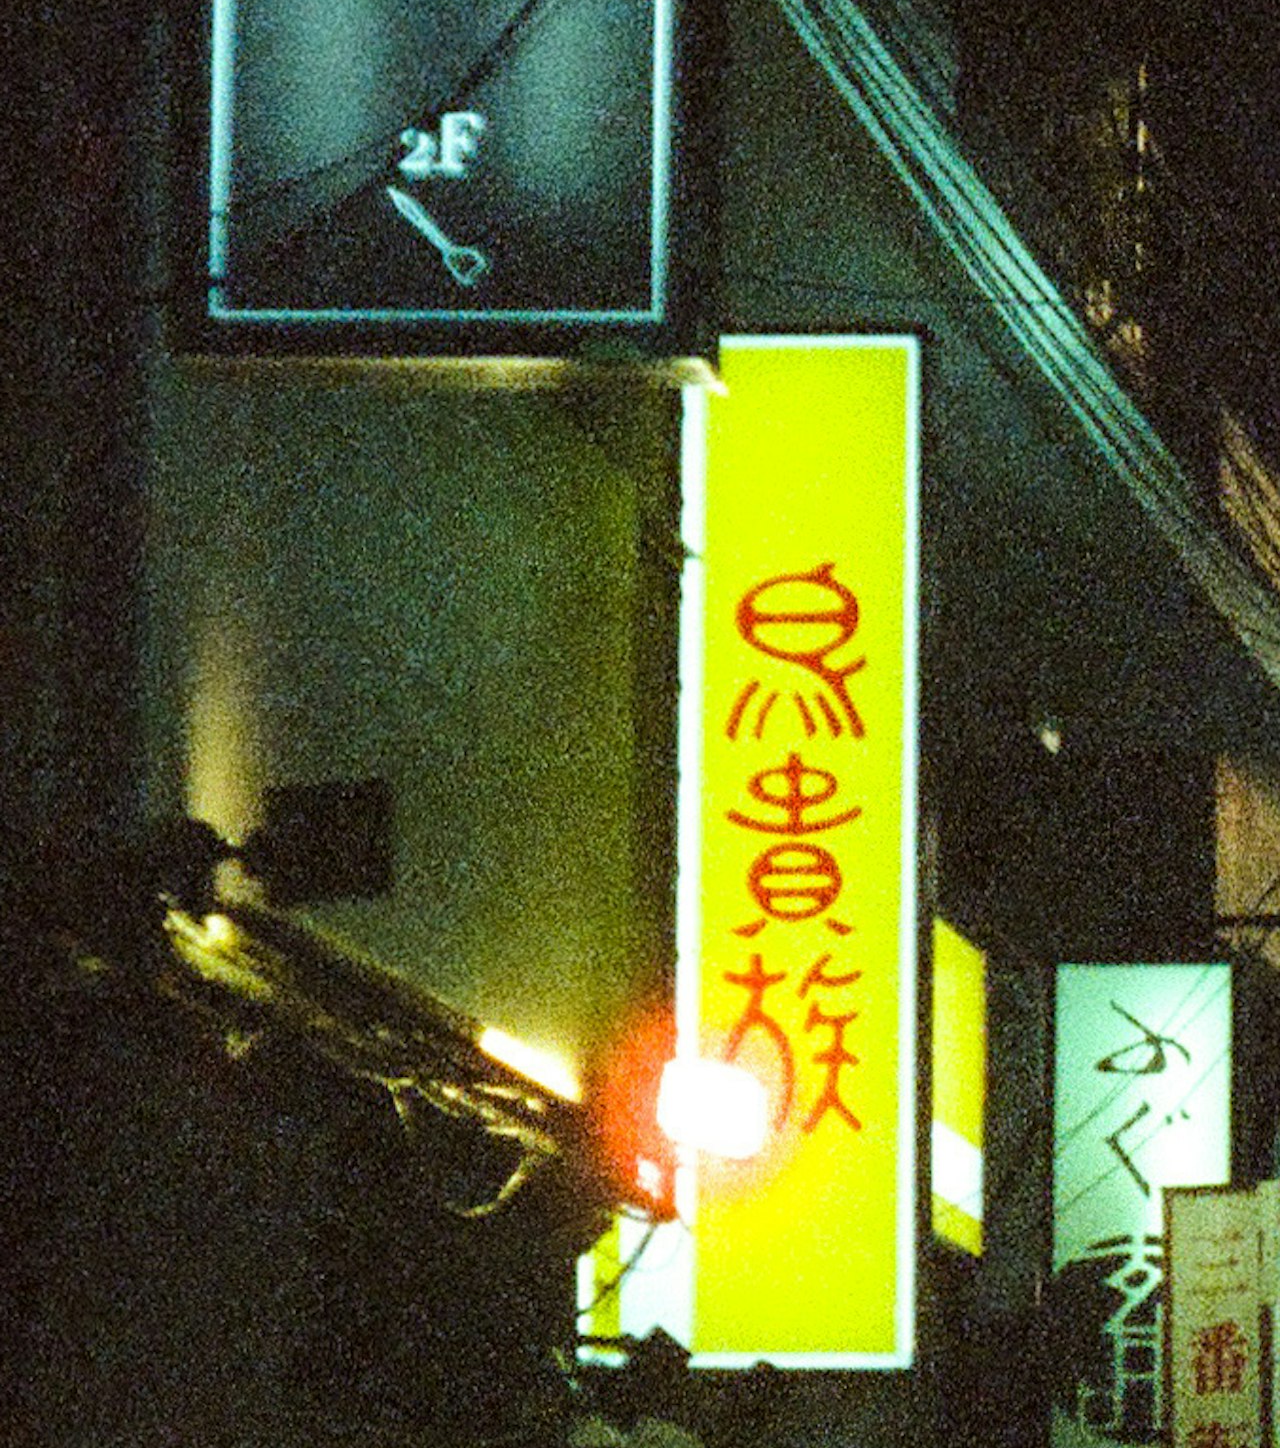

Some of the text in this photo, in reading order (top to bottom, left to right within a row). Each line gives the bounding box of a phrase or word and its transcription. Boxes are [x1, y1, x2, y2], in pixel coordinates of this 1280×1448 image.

[401, 112, 484, 177] 2F
[721, 560, 868, 1138] 鳥貴族
